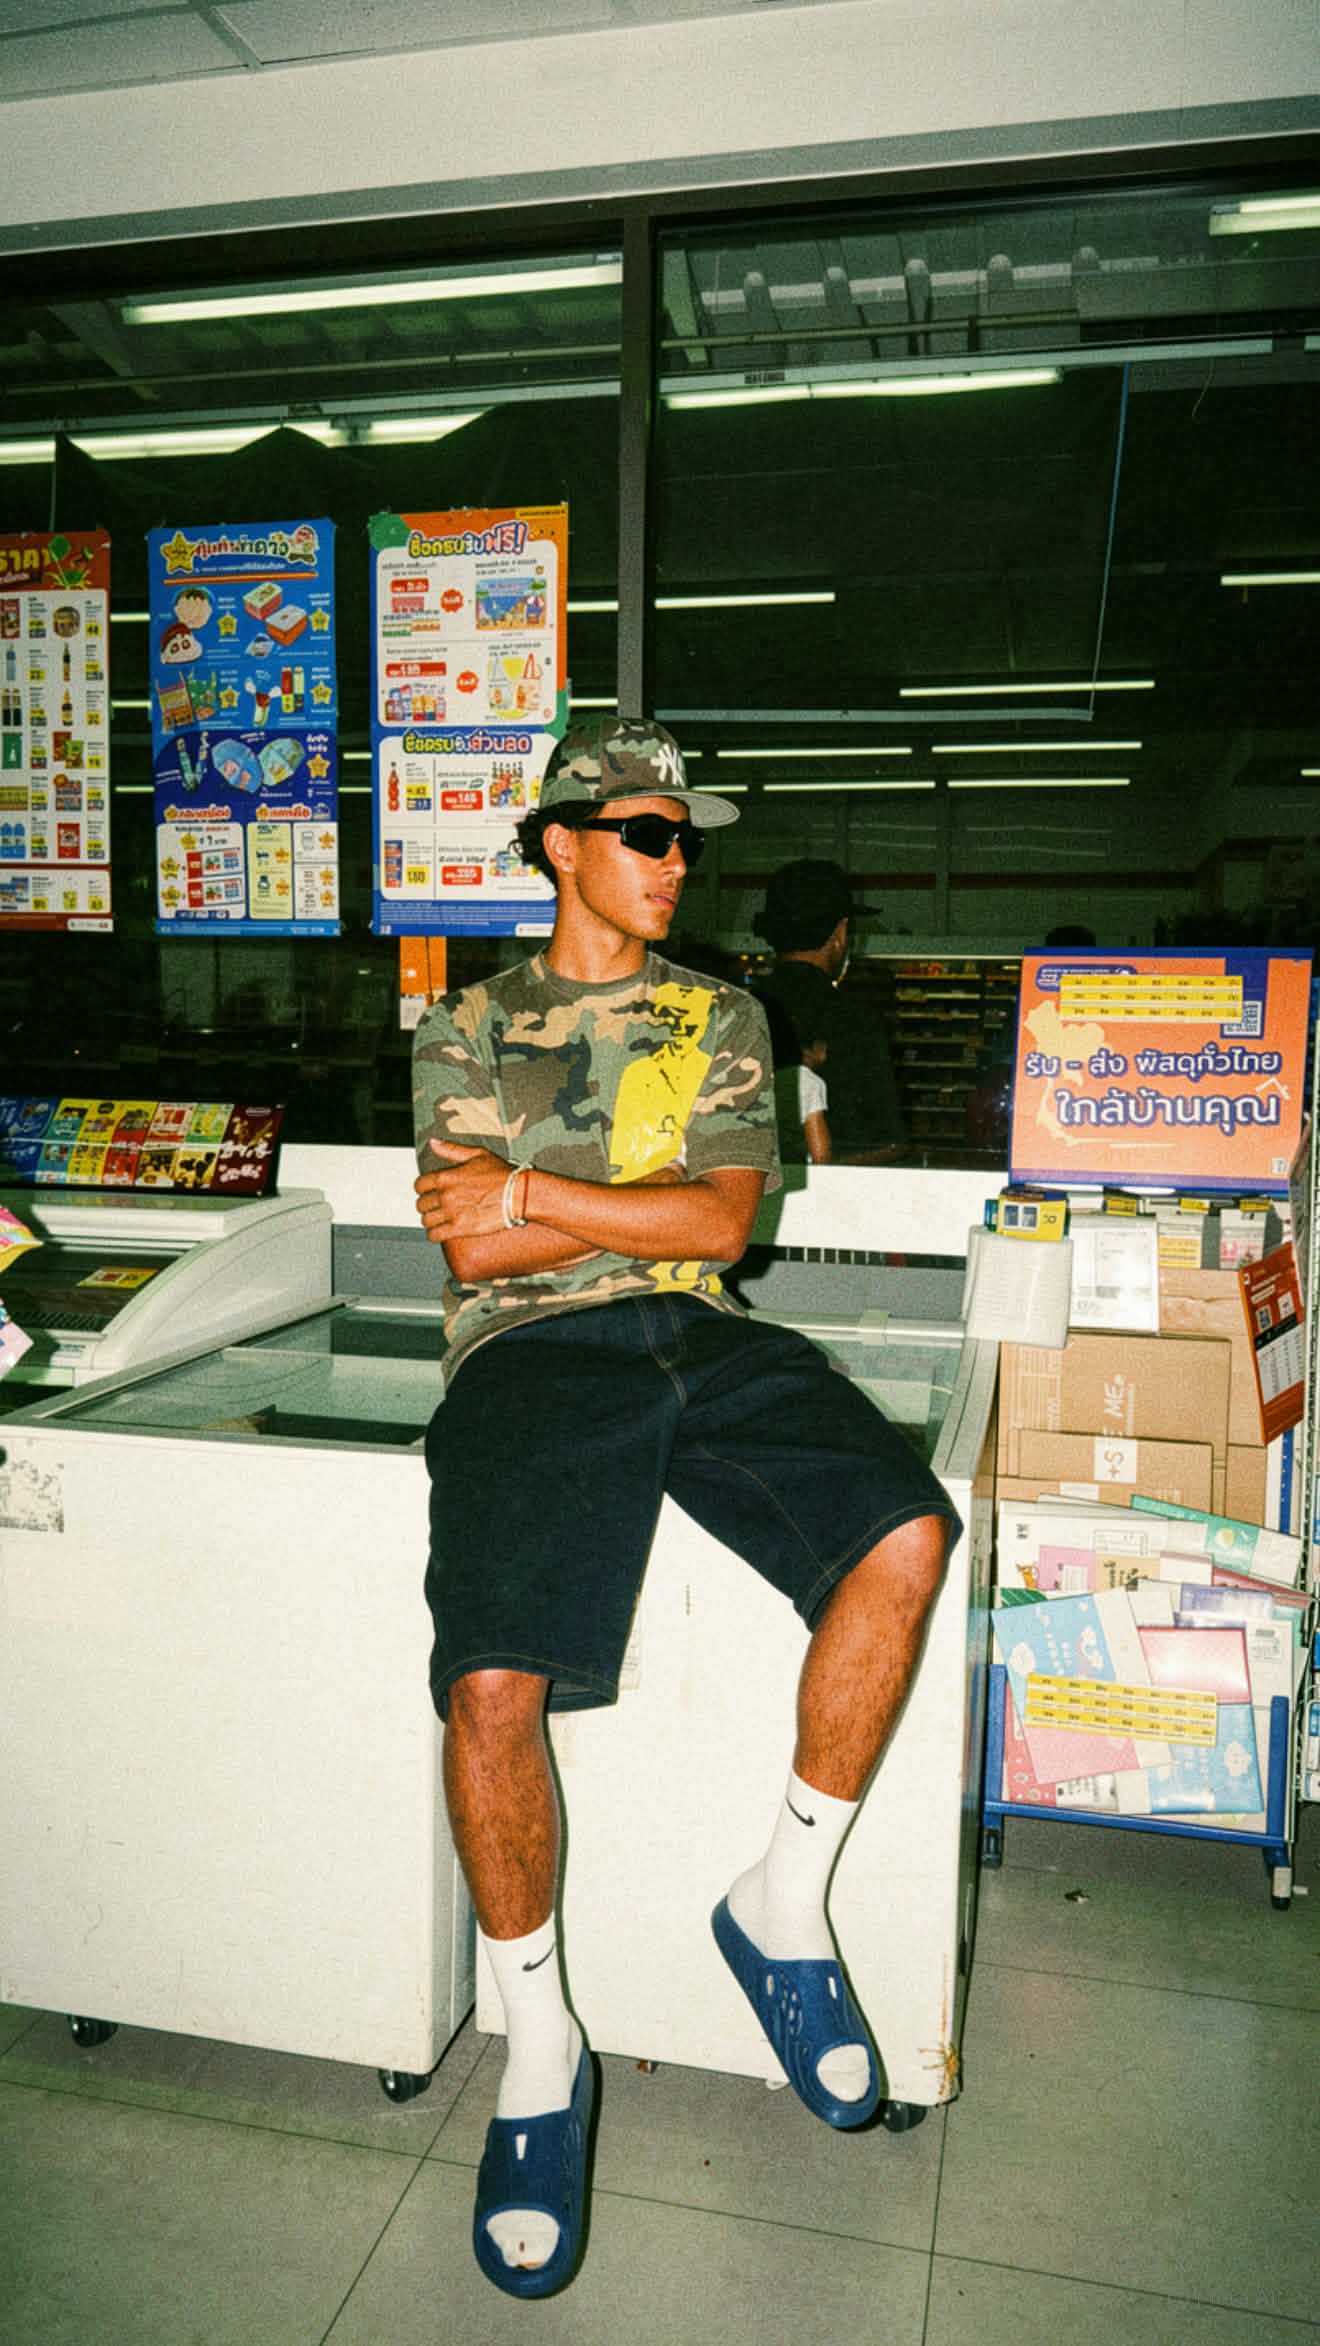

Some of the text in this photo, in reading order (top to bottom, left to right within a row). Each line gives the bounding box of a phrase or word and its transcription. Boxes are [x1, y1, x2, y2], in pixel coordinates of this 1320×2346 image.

[650, 743, 687, 788] NY
[1025, 1052, 1060, 1077] รับ
[1089, 1048, 1126, 1076] ส่ง
[1135, 1042, 1280, 1081] พัสดุทั่วไทย
[1055, 1088, 1279, 1135] ใกล้บ้านคุณ
